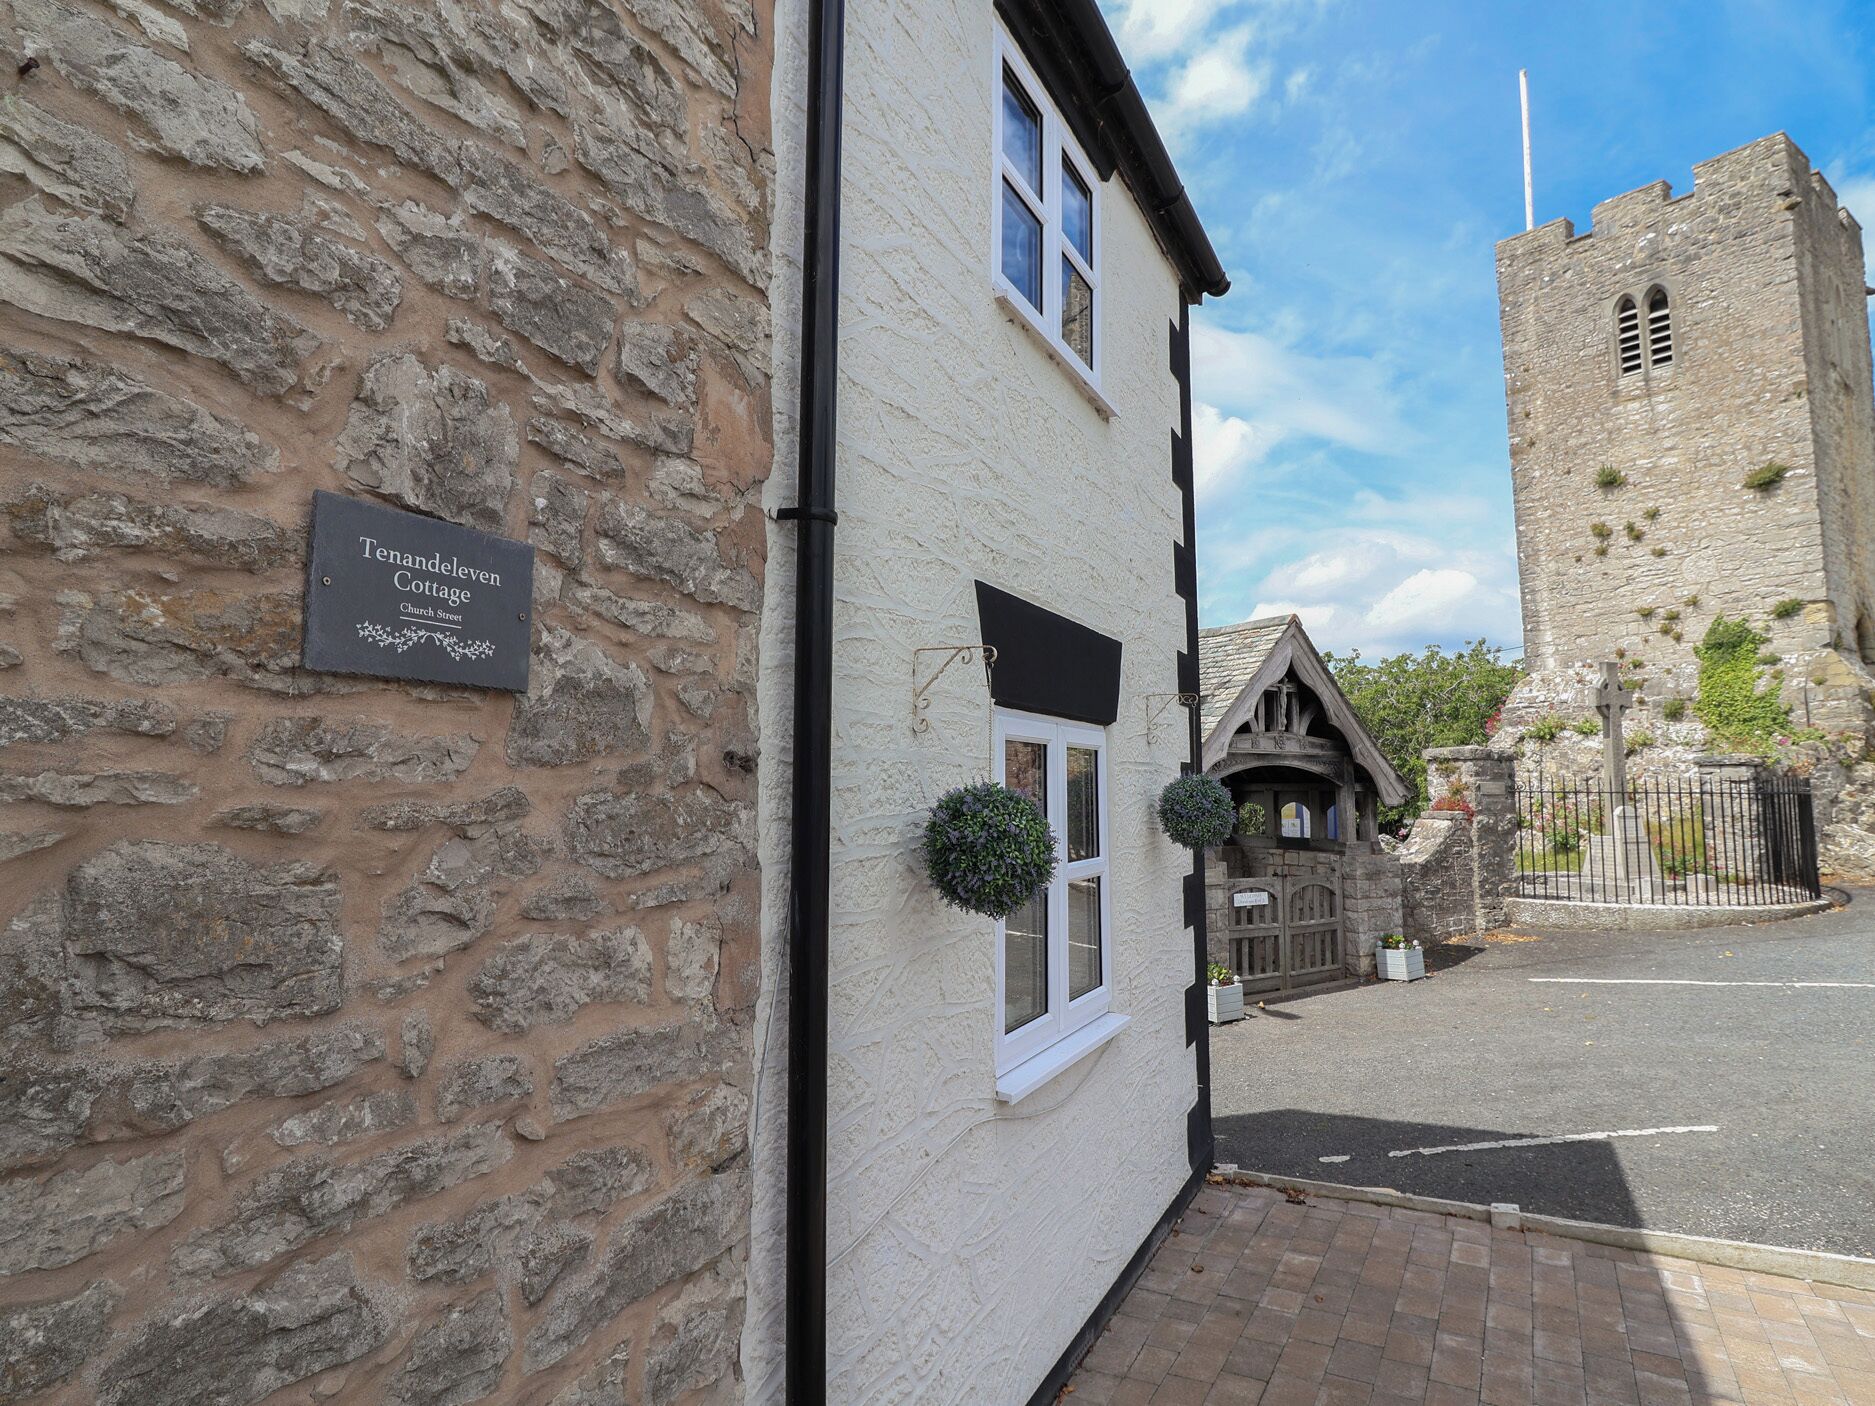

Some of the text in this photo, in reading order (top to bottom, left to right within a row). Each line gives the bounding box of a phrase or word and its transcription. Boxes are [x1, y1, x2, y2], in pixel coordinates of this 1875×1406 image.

[359, 536, 502, 587] Tenandeleven
[393, 570, 471, 607] Cottage
[400, 602, 463, 622] Church Street
